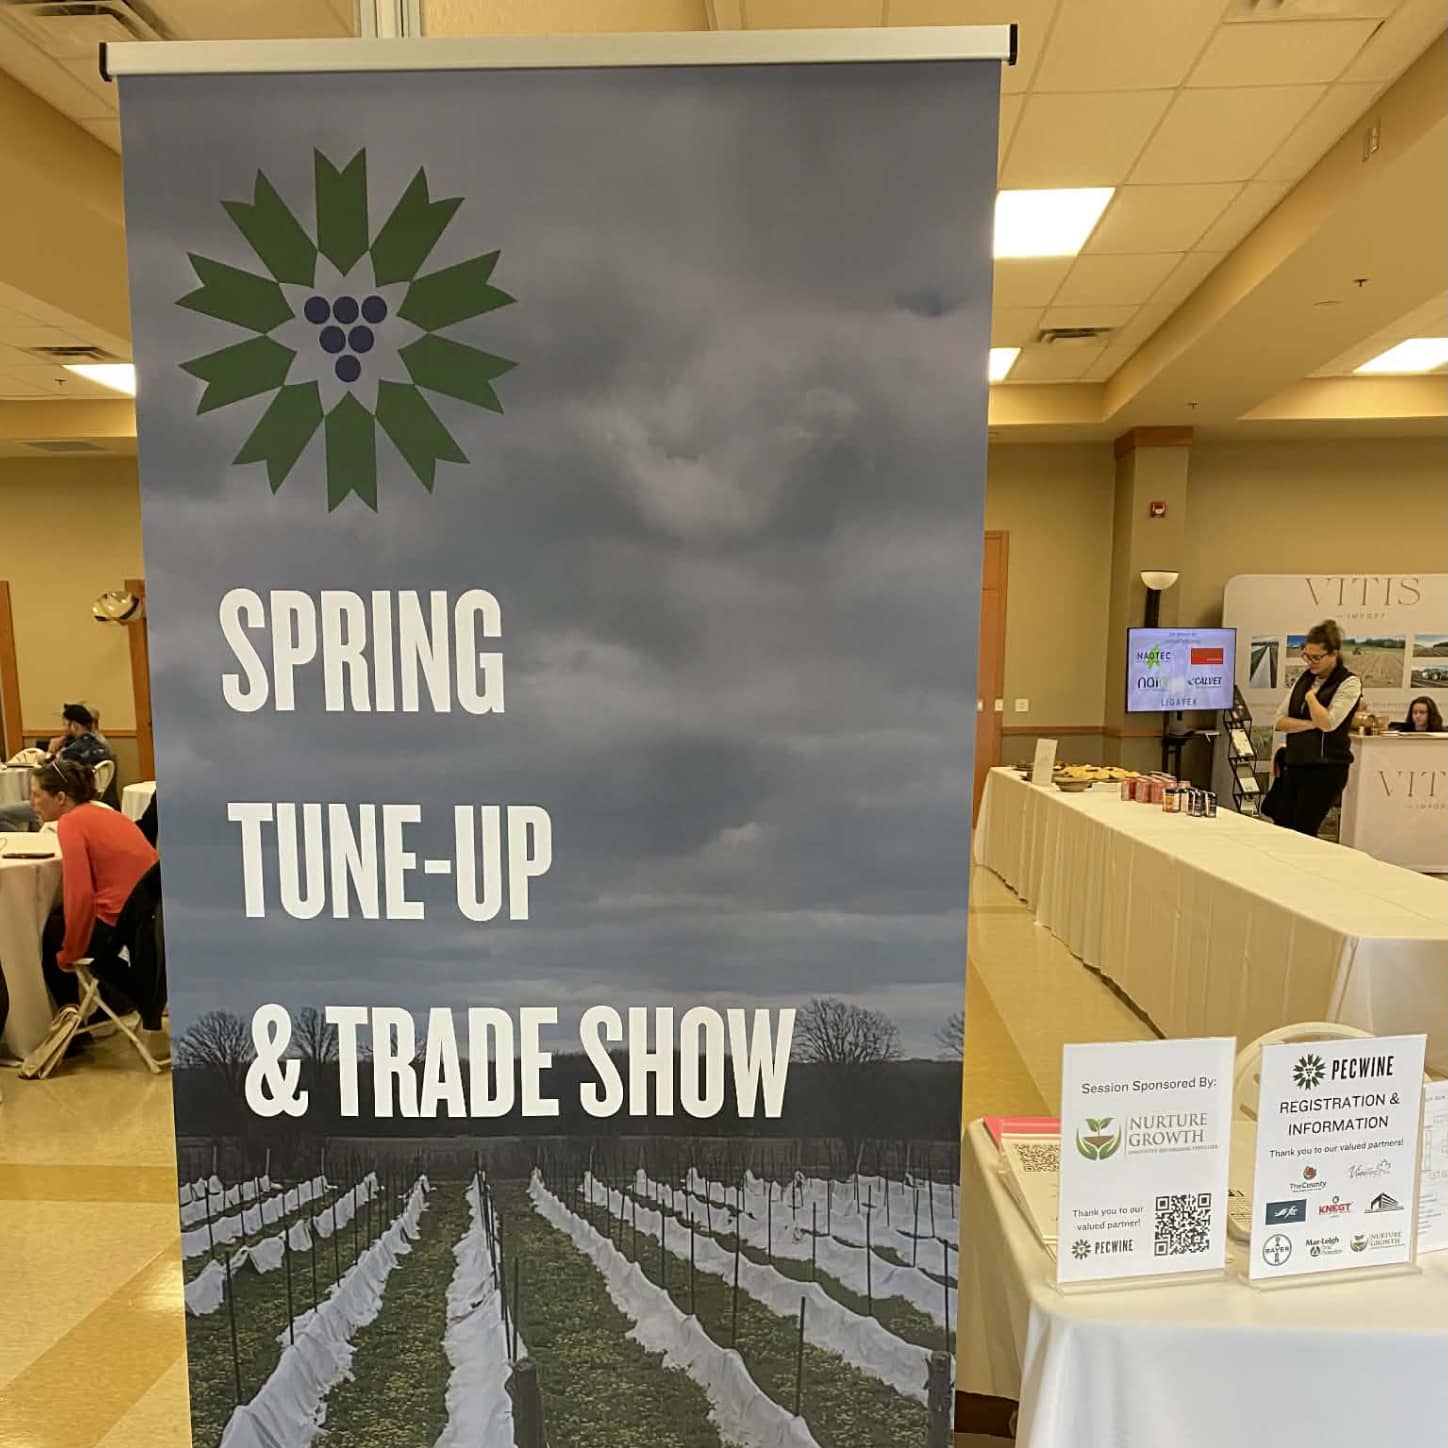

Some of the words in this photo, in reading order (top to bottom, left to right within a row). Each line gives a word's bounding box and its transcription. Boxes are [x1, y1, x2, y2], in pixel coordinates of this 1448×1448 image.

[1305, 576, 1421, 606] VITIS
[219, 588, 505, 715] SPRING
[227, 801, 552, 922] TUNE-UP
[245, 1003, 309, 1118] &
[325, 1006, 560, 1119] TRADE
[579, 1005, 796, 1119] SHOW
[1331, 1055, 1395, 1081] PECWINE
[1081, 1082, 1129, 1095] Session
[1132, 1077, 1196, 1093] Sponsored
[1199, 1076, 1217, 1088] By:
[1280, 1093, 1386, 1114] REGISTRATION
[1389, 1091, 1401, 1105] &
[1129, 1112, 1208, 1131] NURTURE
[1288, 1115, 1389, 1137] INFORMATION
[1128, 1129, 1204, 1147] GROWTH
[1269, 1148, 1295, 1159] Thank
[1297, 1149, 1312, 1158] you
[1314, 1146, 1321, 1154] to
[1324, 1146, 1337, 1154] our
[1340, 1140, 1367, 1151] valued
[1368, 1138, 1405, 1151] partners!
[1072, 1207, 1100, 1218] Thank
[1101, 1207, 1117, 1217] you
[1119, 1206, 1128, 1215] to
[1130, 1205, 1145, 1214] our
[1318, 1202, 1351, 1215] KNEGT
[1077, 1220, 1105, 1232] valued
[1107, 1218, 1141, 1230] partner!
[1095, 1239, 1134, 1255] PECWINE
